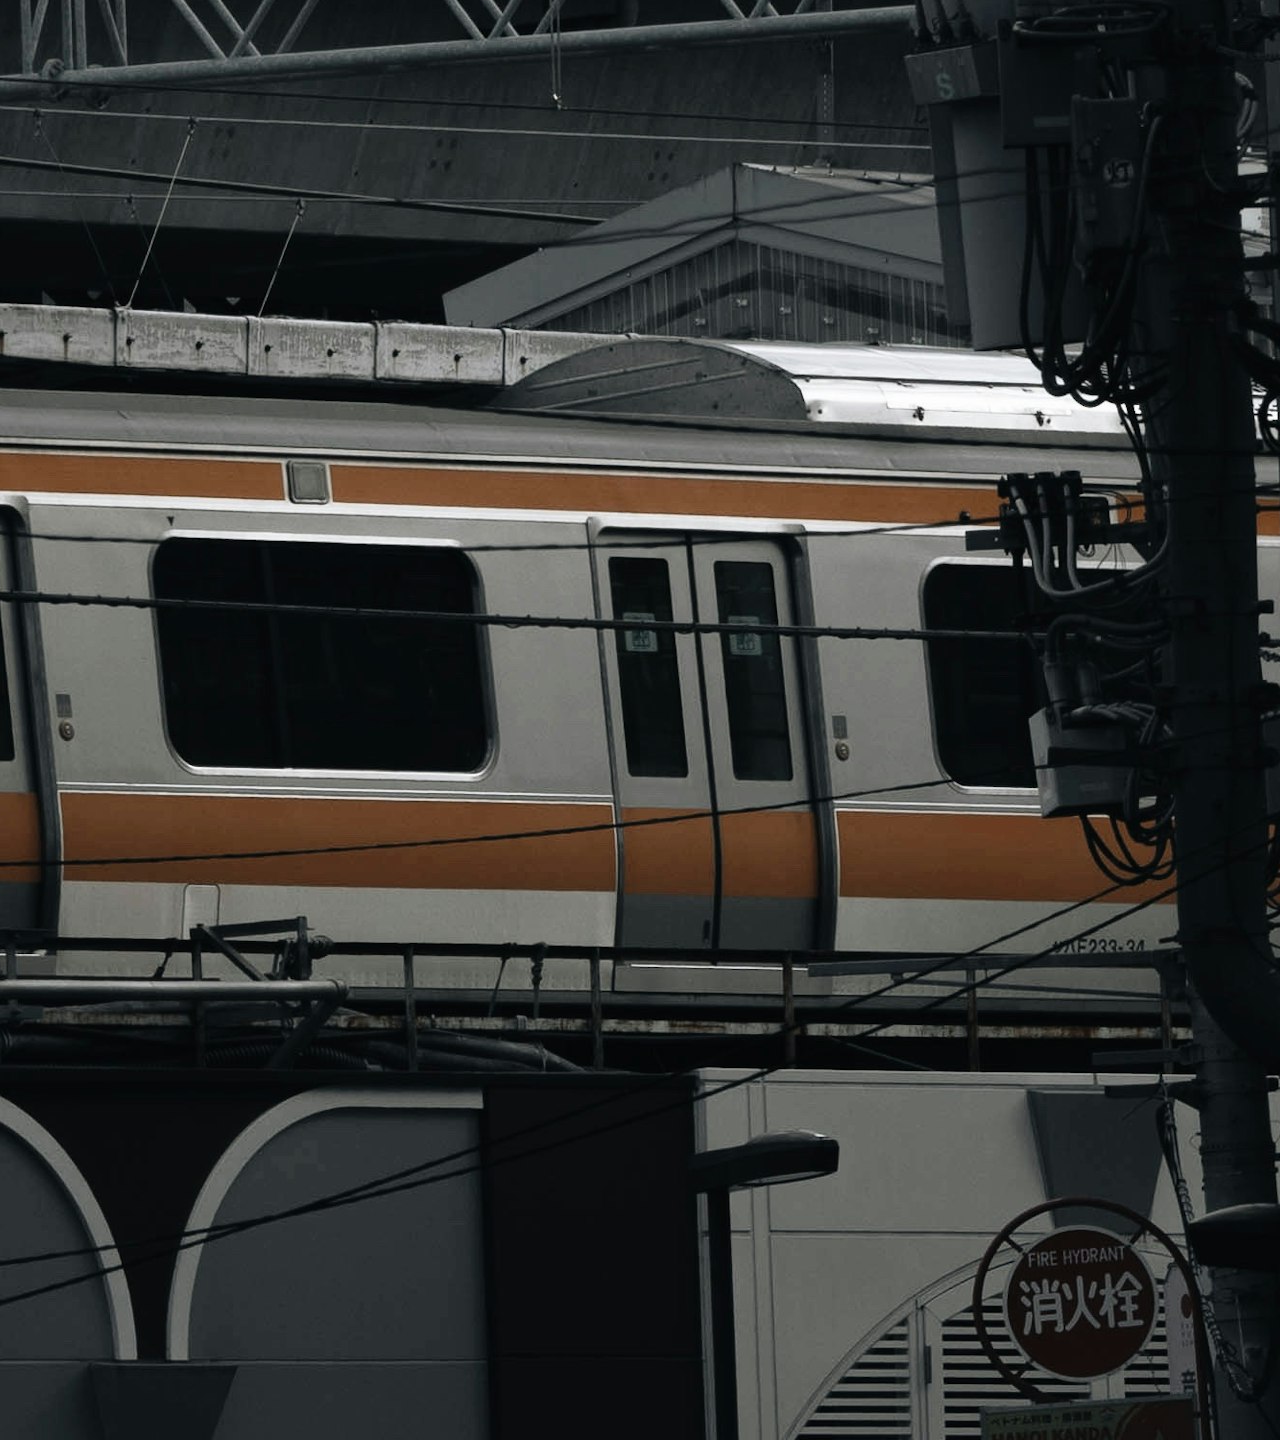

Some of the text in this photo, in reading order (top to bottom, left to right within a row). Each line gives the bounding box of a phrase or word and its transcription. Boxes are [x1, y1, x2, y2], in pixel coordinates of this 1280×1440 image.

[1027, 1244, 1126, 1269] FIRE HYDRANT
[1019, 1269, 1145, 1338] 消火栓
